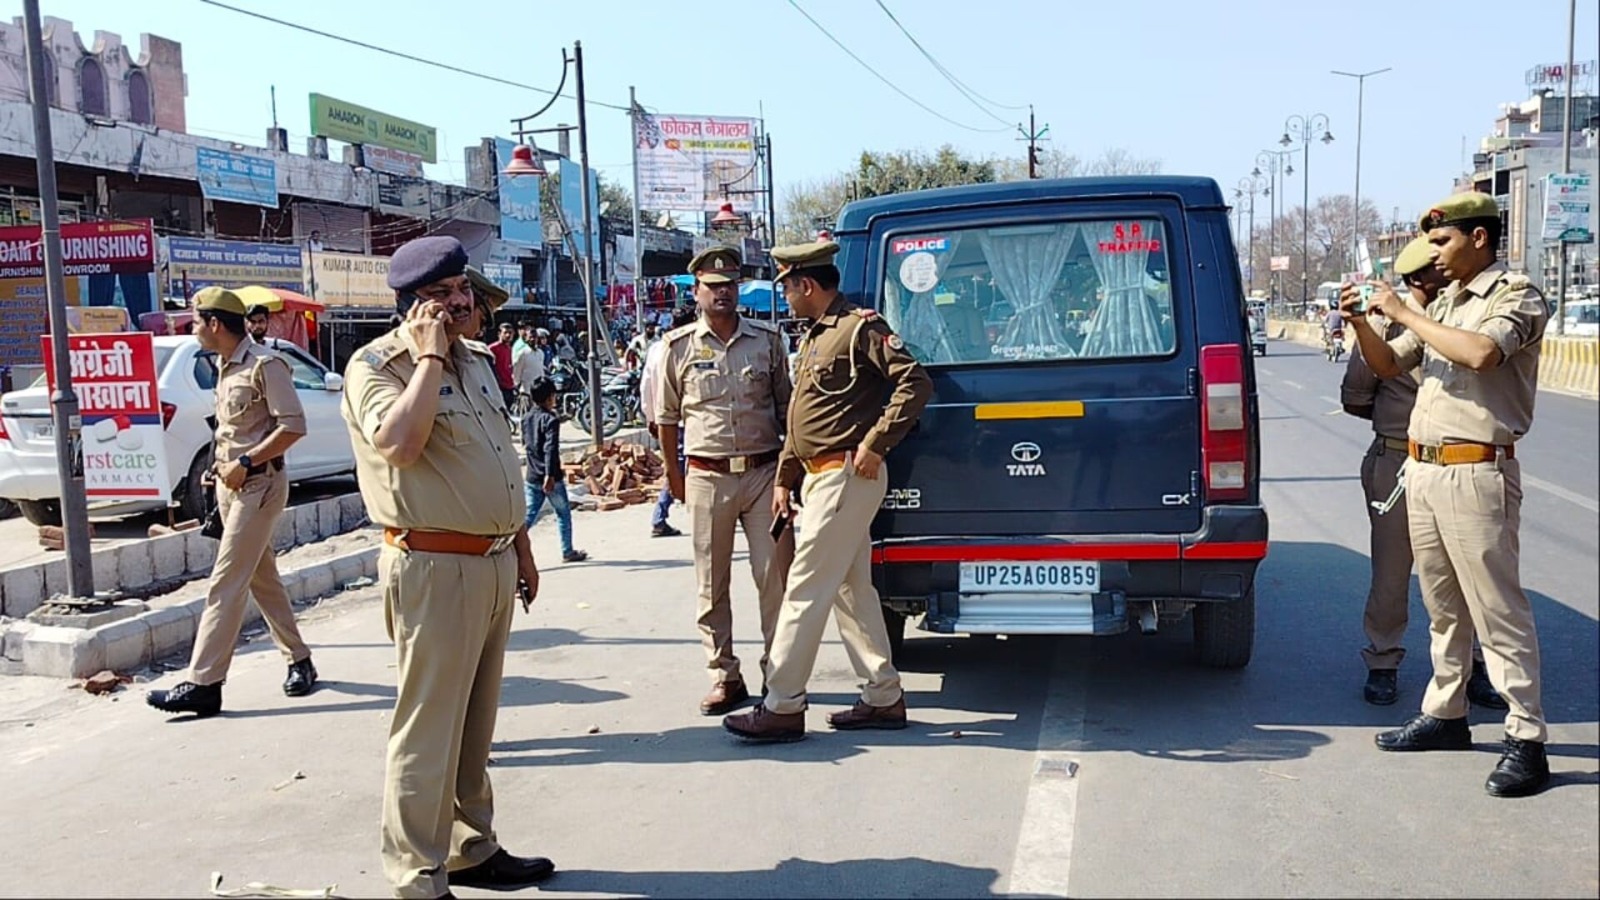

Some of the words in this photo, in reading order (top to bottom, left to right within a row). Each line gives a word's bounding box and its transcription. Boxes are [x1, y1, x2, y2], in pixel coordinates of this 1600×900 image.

[661, 116, 702, 136] फोकस
[704, 117, 750, 138] नेत्रालय
[60, 235, 148, 261] URNISHING
[895, 239, 946, 253] POLICE
[1098, 239, 1160, 253] TRAFFIC
[0, 266, 43, 277] URNISHIN
[322, 258, 352, 273] KUMAR
[353, 260, 374, 274] AUTO
[84, 451, 157, 470] rstcare
[1006, 464, 1046, 476] TATA
[89, 473, 155, 484] ARMACY
[884, 488, 921, 499] UMO
[1162, 493, 1190, 506] CX
[881, 499, 921, 509] OLD
[974, 565, 1096, 586] UP25AG0859
